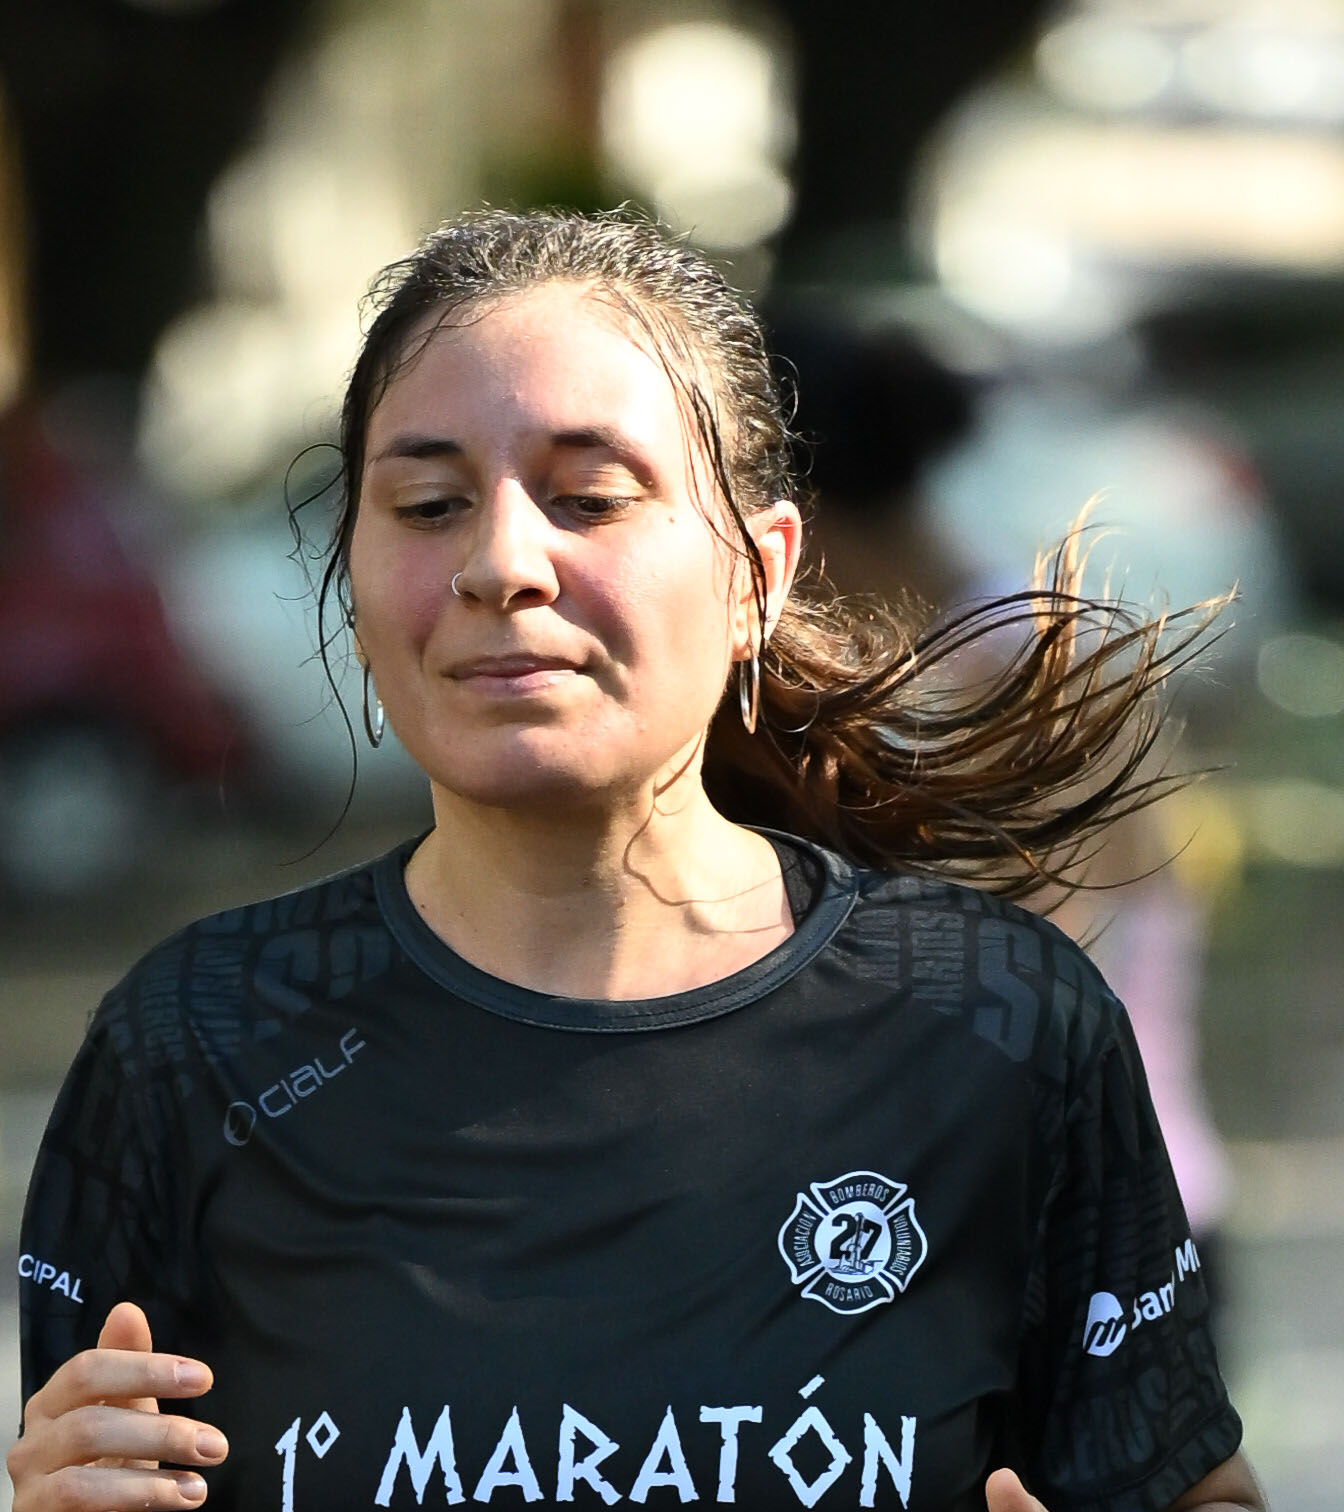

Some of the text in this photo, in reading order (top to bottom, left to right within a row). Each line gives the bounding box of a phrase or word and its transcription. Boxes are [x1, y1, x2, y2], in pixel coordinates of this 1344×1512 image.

[829, 1183, 890, 1204] BOMBEROS
[829, 1212, 883, 1260] 27
[825, 1282, 874, 1302] ROSARIO
[374, 1374, 917, 1510] MARATÓN
